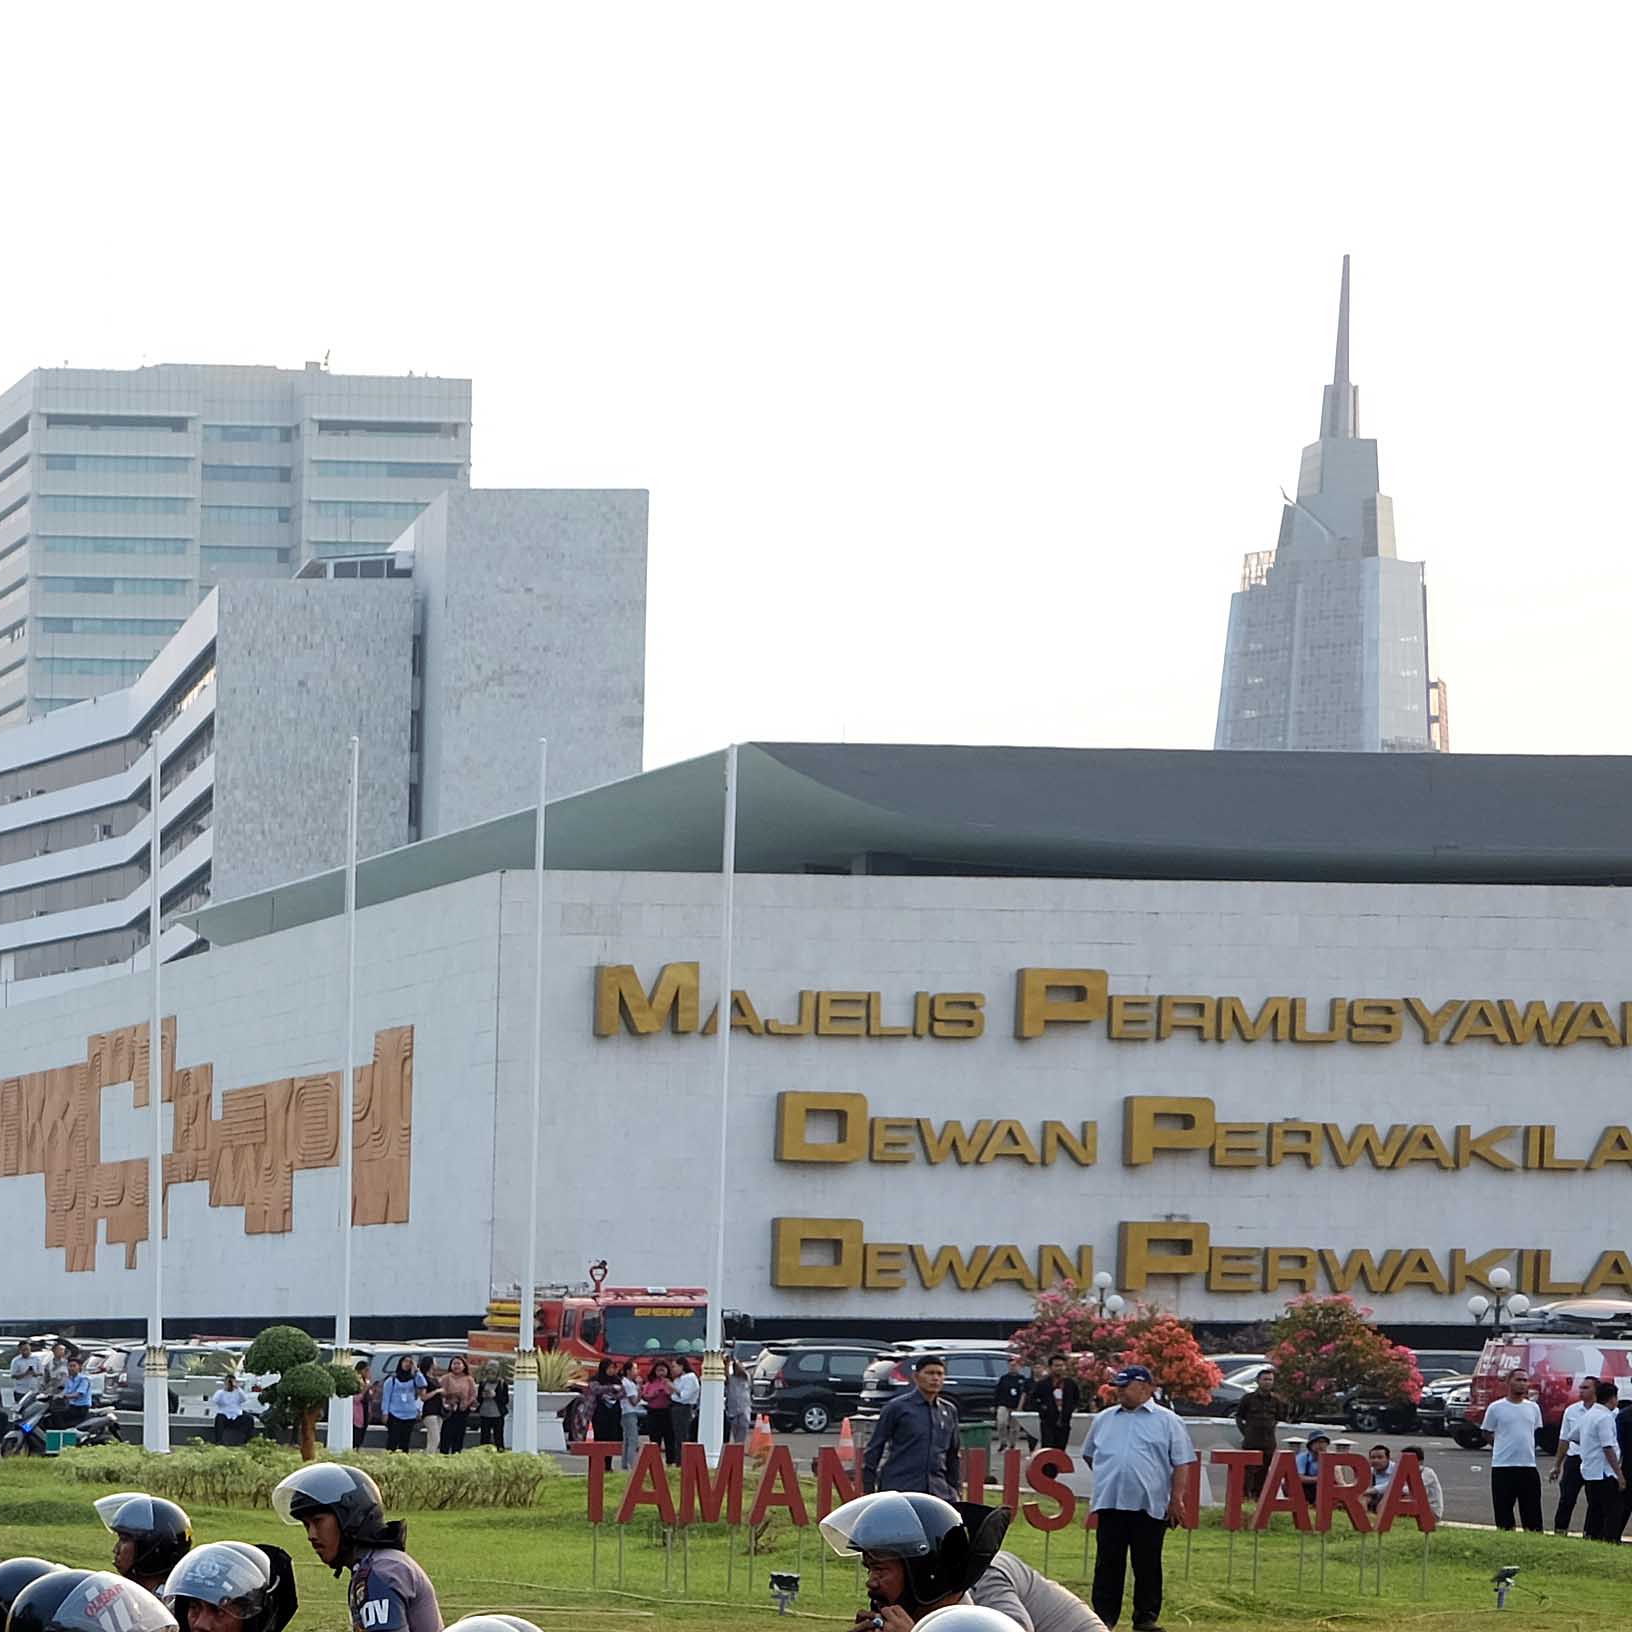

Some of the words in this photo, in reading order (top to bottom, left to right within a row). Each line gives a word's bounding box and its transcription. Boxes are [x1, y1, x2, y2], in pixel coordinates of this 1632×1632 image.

[594, 961, 986, 1038] MAJELIS
[1016, 968, 1632, 1046] PERMUSYAWA
[776, 1091, 1098, 1166] DEWAN
[1123, 1096, 1632, 1170] PERWAKILA
[771, 1217, 1094, 1290] DEWAN
[570, 1442, 865, 1526] TAMAN
[960, 1446, 1436, 1533] USTARA
